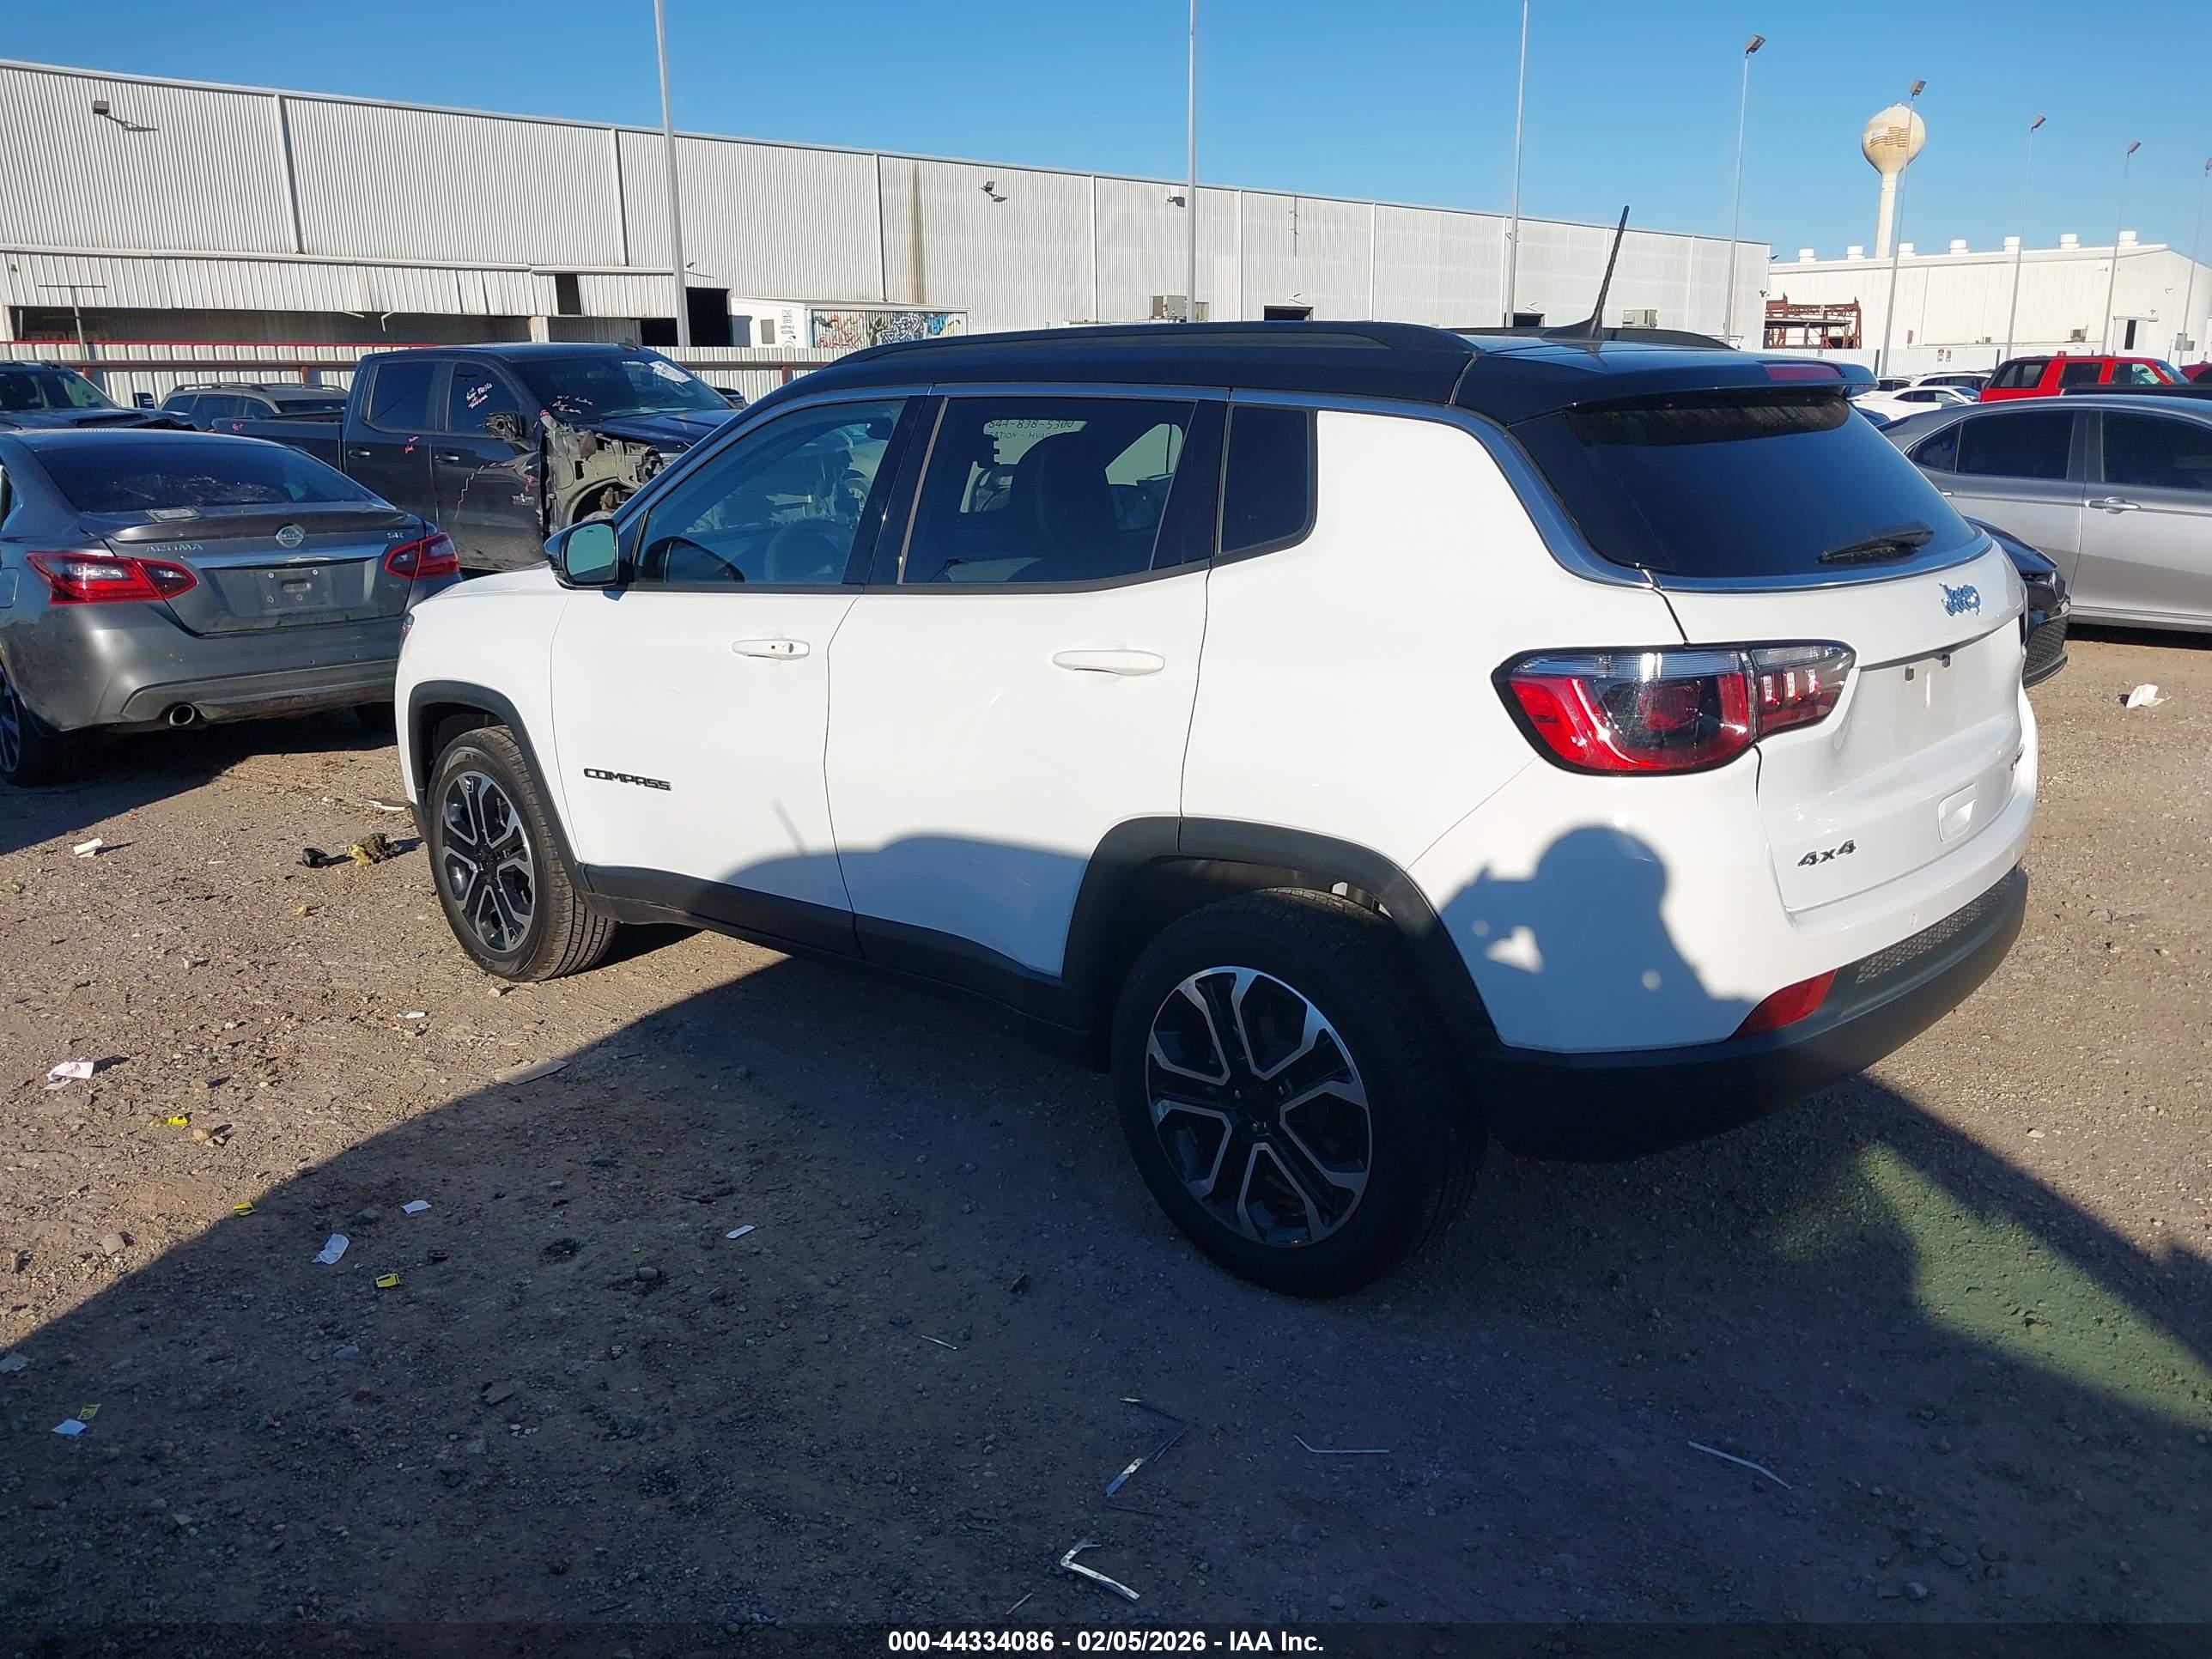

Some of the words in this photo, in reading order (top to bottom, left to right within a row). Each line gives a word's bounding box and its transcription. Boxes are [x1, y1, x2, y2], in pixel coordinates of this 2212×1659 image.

[145, 544, 204, 553] ALTIMA
[1939, 583, 1981, 616] Jeep
[584, 769, 672, 791] COMPASS
[1797, 839, 1856, 867] 4x4
